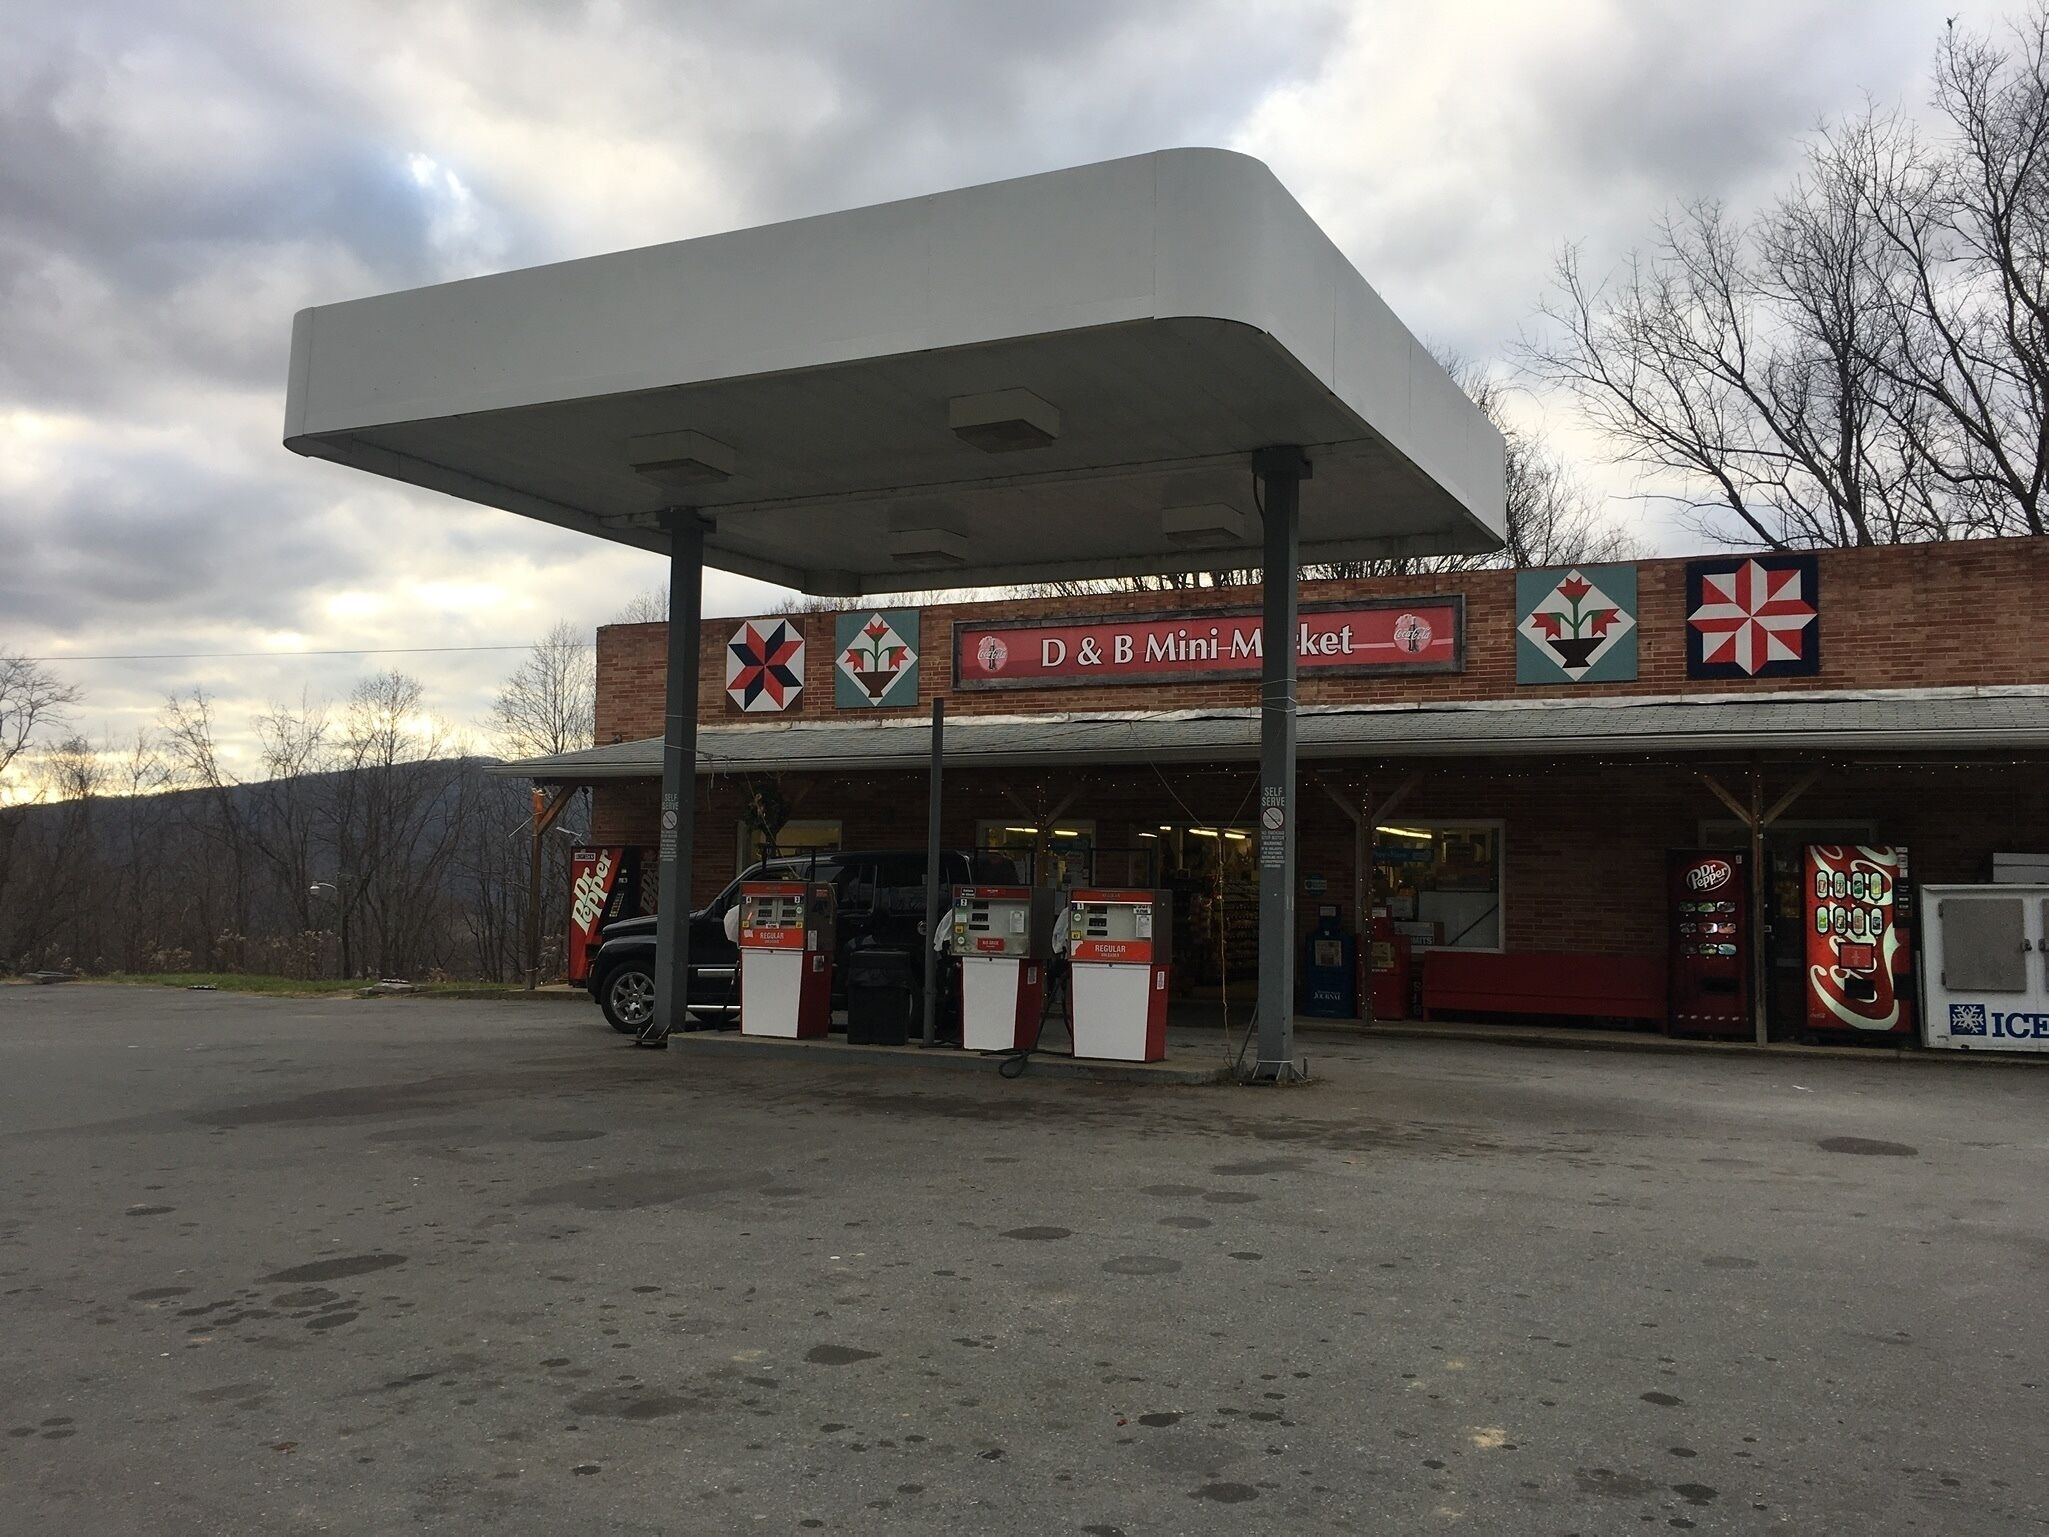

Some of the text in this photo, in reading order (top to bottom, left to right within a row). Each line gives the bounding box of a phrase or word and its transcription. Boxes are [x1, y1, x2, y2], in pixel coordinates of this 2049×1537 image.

[1041, 623, 1353, 667] D & B Mini Mket
[664, 793, 678, 801] SELF
[1264, 787, 1283, 796] SELF
[1261, 796, 1285, 806] SERVE
[1689, 867, 1728, 890] Pepper
[1700, 864, 1716, 877] Dr
[572, 849, 612, 935] Pepper
[574, 867, 592, 906] Dr
[1095, 945, 1126, 953] REGULAR
[1991, 1012, 2049, 1039] ICE
